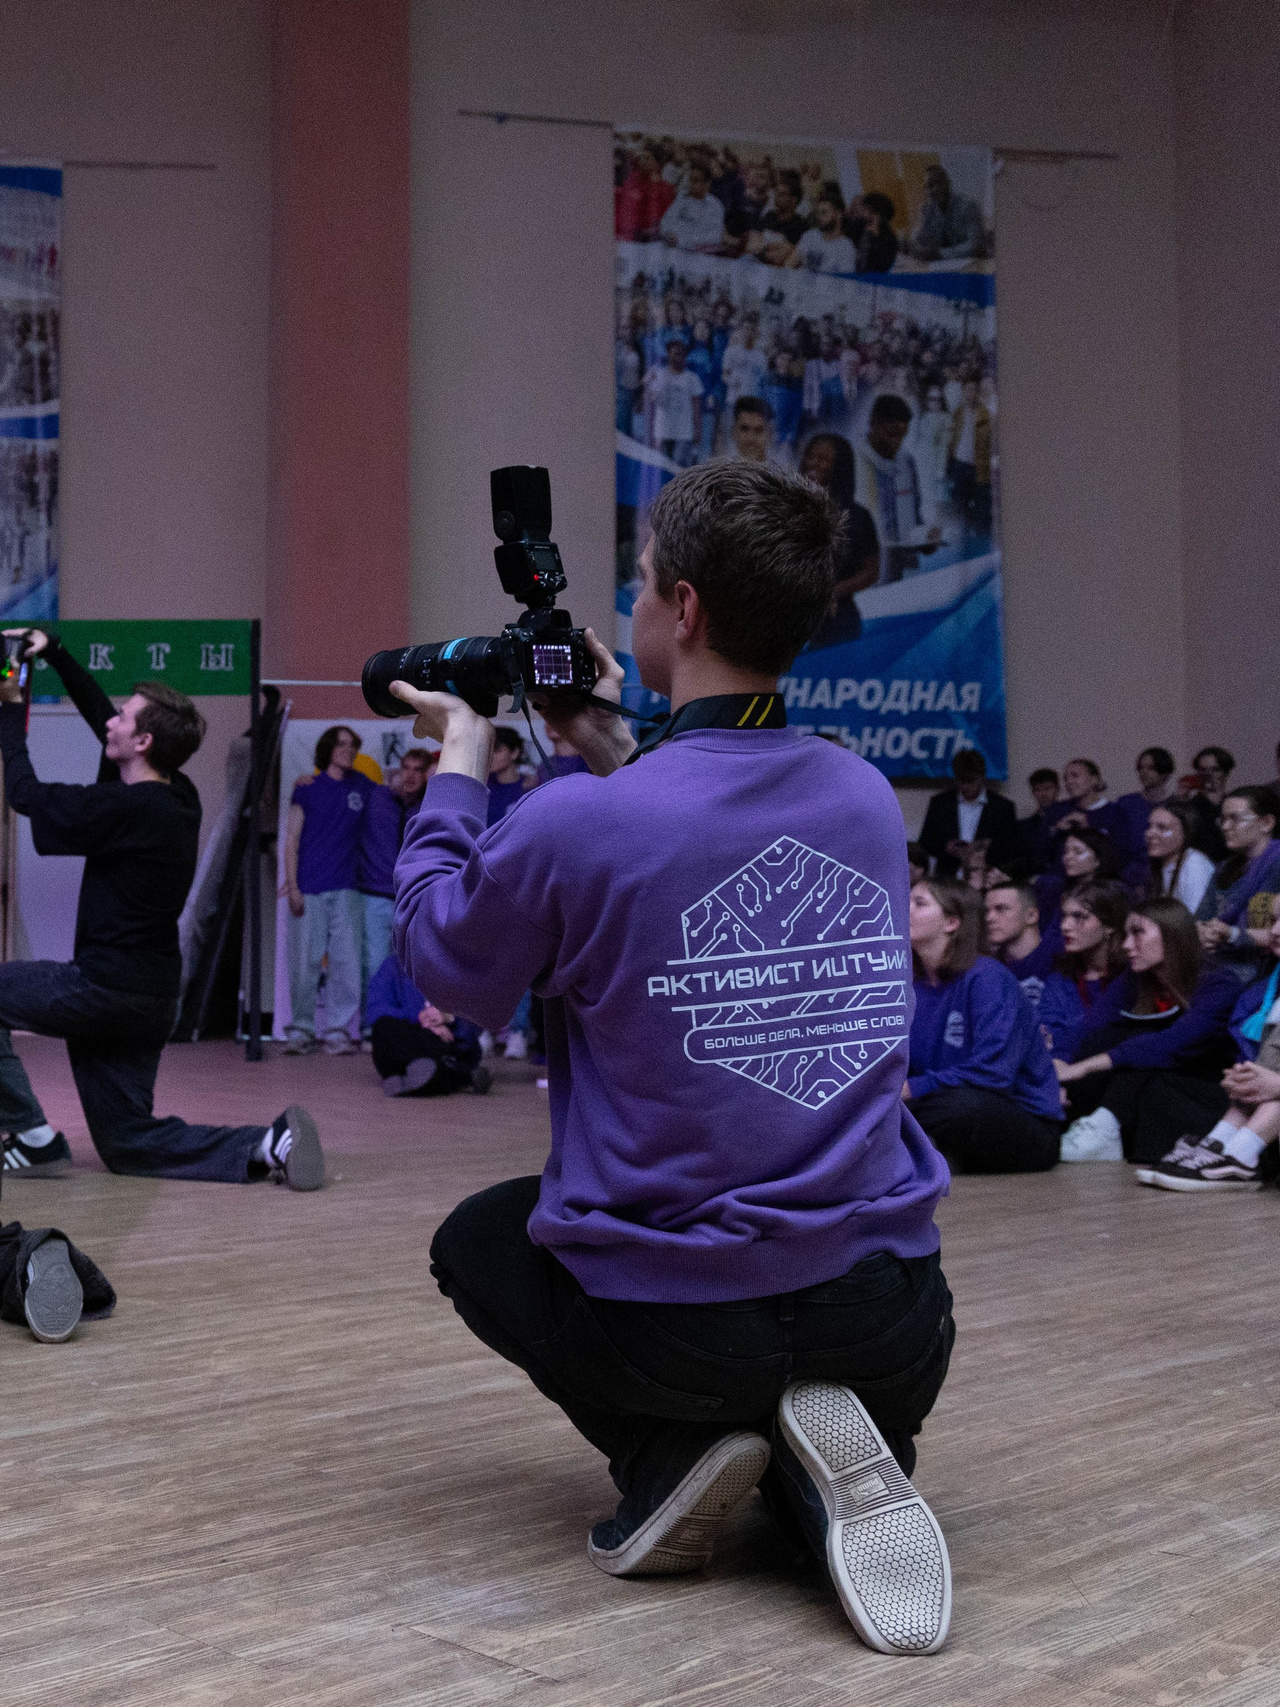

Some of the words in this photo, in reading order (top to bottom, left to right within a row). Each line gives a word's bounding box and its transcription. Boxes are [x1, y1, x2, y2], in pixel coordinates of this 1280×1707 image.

[777, 676, 981, 715] НАРОДНАЯ
[647, 961, 805, 997] АКТИВИСТ
[704, 1033, 766, 1050] БОЛЬШЕ
[768, 1027, 804, 1043] ДЕЛА,
[806, 1018, 869, 1037] МЕНЬШЕ
